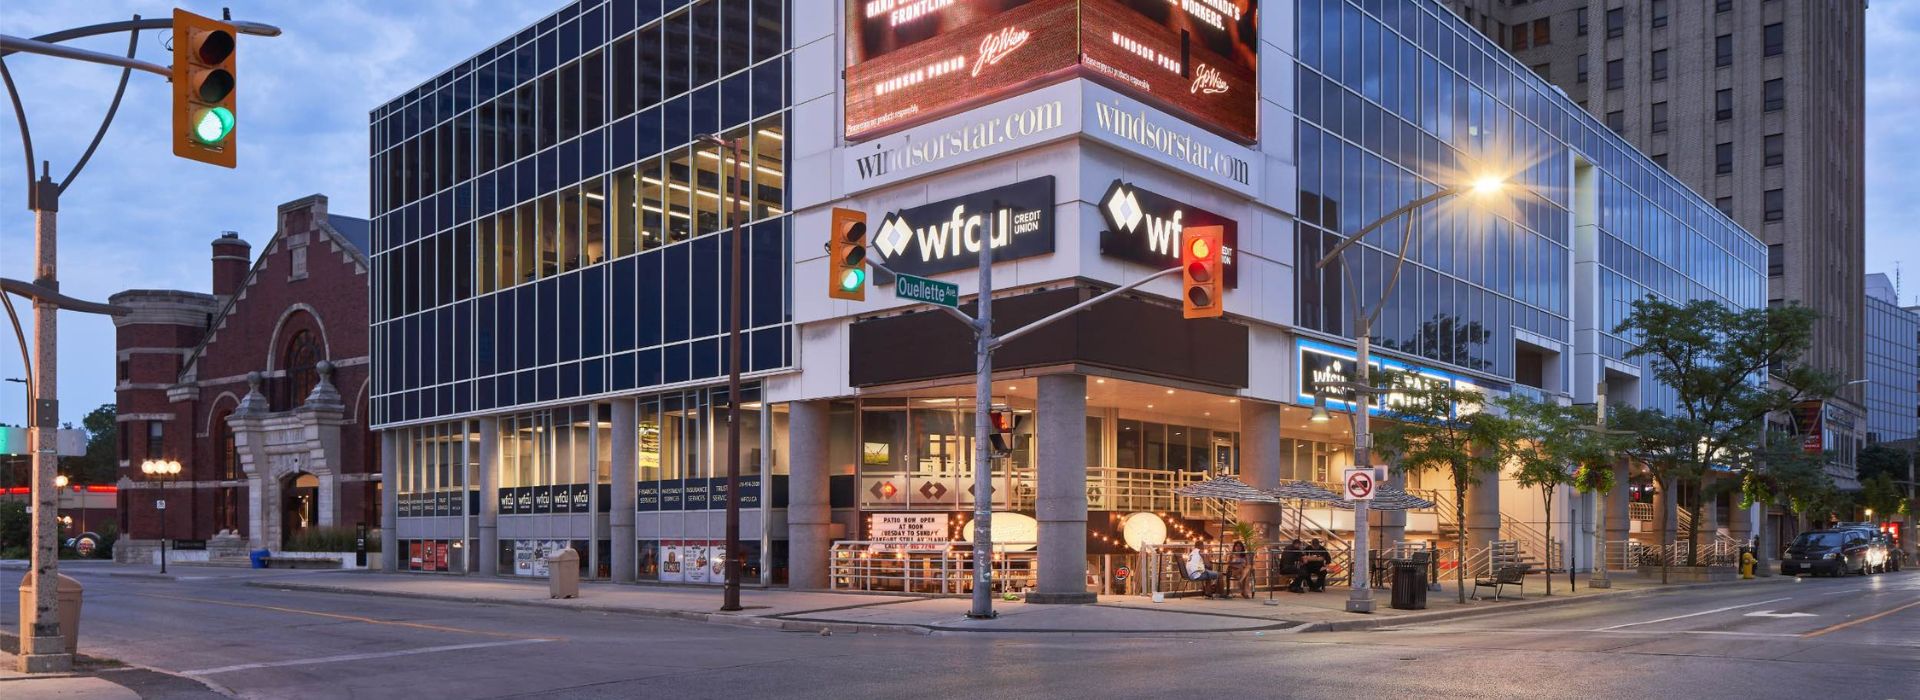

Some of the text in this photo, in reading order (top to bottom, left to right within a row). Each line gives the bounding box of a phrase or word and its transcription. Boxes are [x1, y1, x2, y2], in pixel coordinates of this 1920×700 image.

[1112, 31, 1182, 75] WINDSOR PROU
[855, 100, 1063, 182] windsorstar.com
[1095, 98, 1250, 187] windsorstar.com
[1014, 209, 1041, 224] CREDIT
[916, 204, 1008, 262] wfcu
[1014, 220, 1039, 235] UNION
[1145, 209, 1183, 259] wf
[898, 276, 945, 302] Ouellette
[500, 495, 514, 505] wfcu
[518, 494, 532, 505] wfcu
[536, 493, 550, 504] wfcu
[554, 492, 569, 504] wfcu
[573, 492, 589, 503] wfcu
